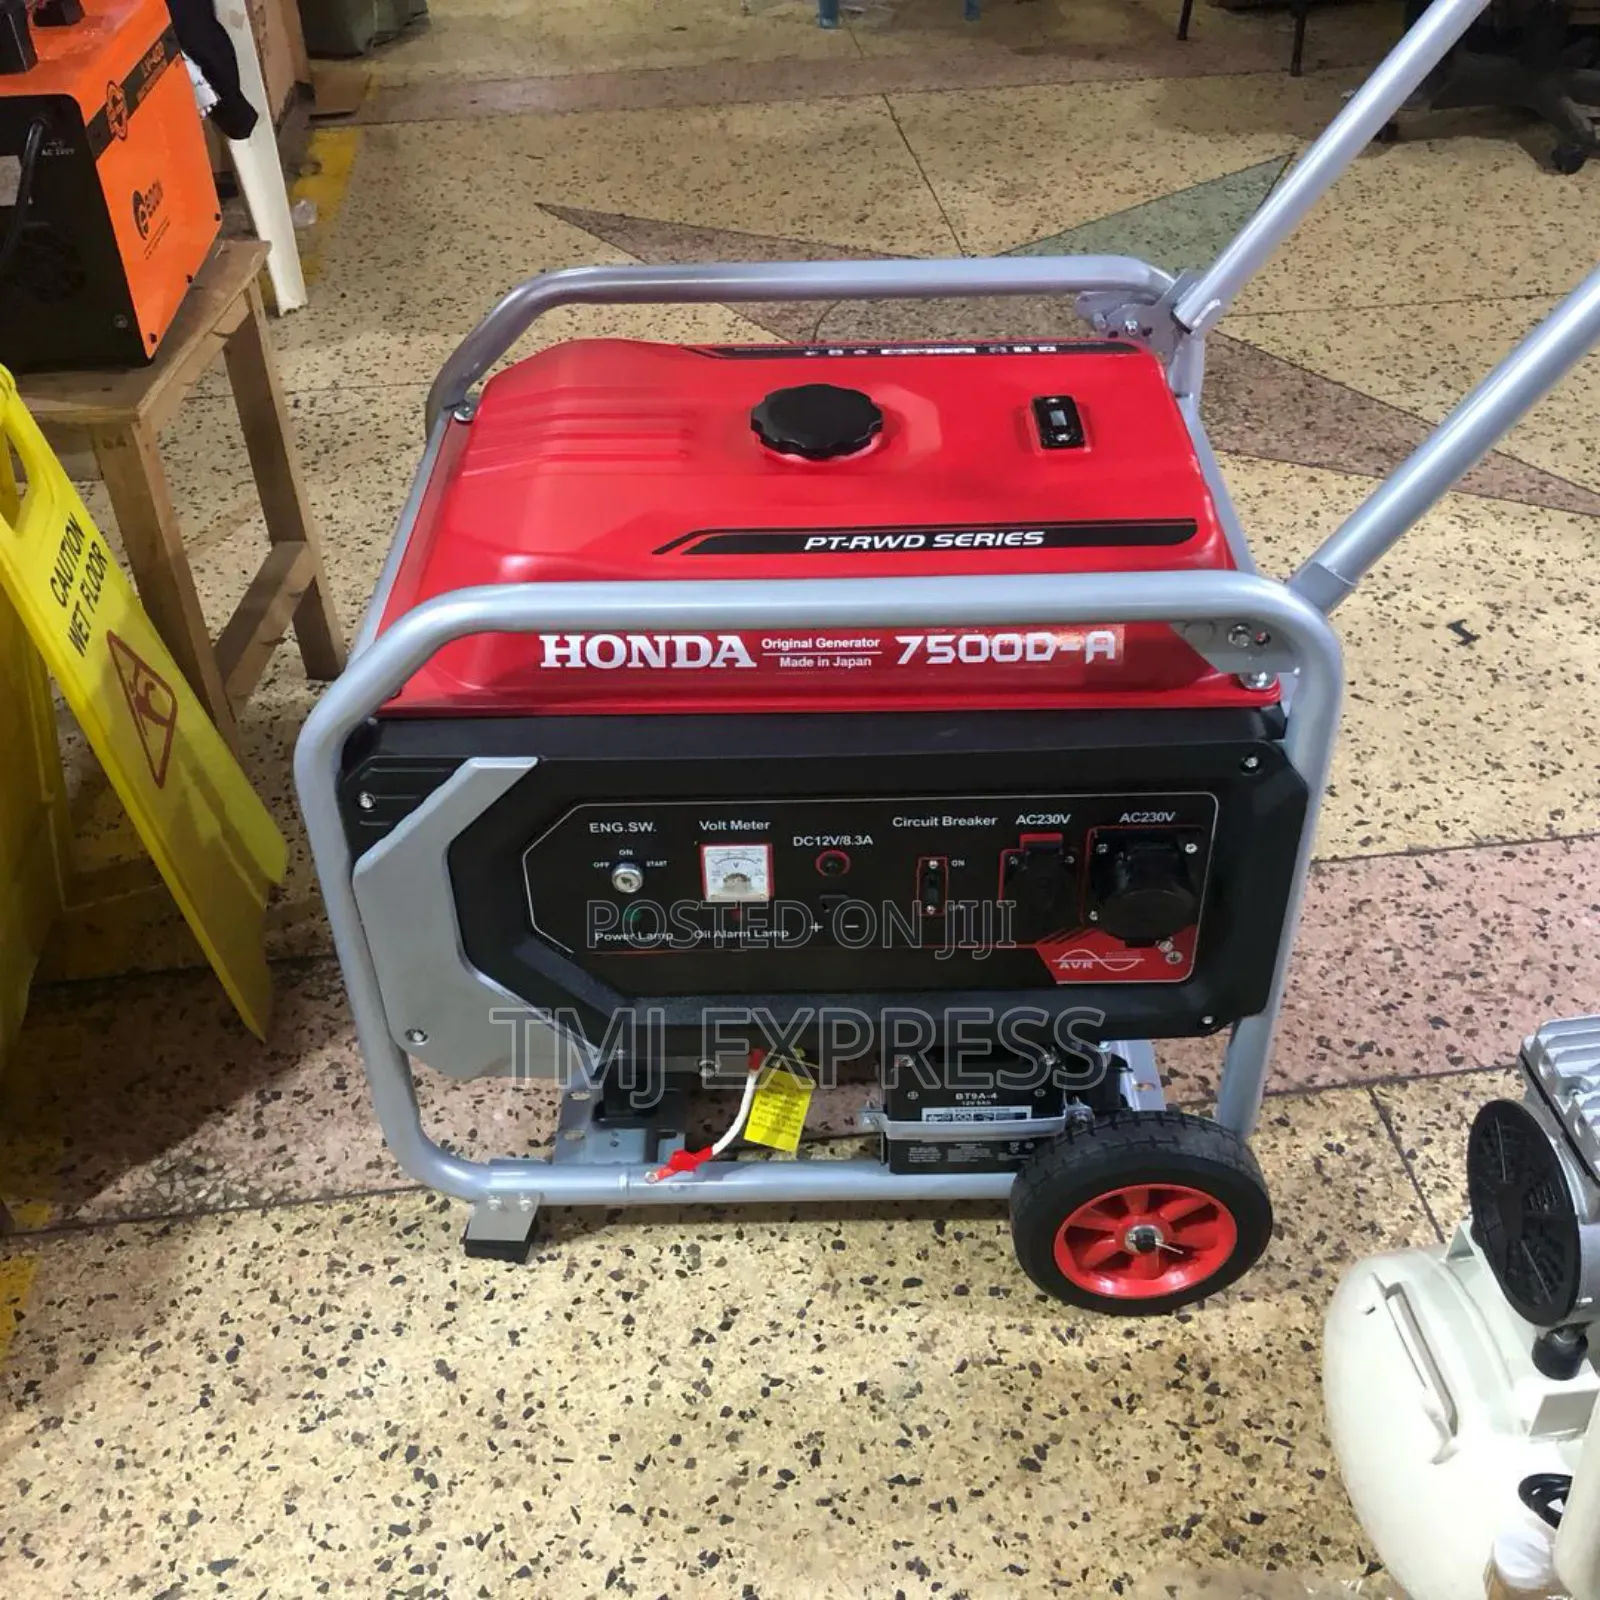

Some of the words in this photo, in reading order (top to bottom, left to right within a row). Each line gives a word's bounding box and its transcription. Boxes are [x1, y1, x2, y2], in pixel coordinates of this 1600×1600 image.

[803, 533, 924, 552] PT-RWD
[931, 531, 1045, 549] SERIES
[50, 511, 86, 608] CAUTION
[68, 600, 92, 659] WET
[80, 540, 108, 614] FLOOR
[761, 637, 813, 651] Original
[815, 637, 881, 648] Generator
[895, 631, 1118, 665] 7500D-A
[539, 634, 757, 669] HONDA
[779, 656, 815, 668] Made
[817, 656, 830, 667] in
[832, 656, 873, 669] Japan
[892, 815, 939, 828] Circuit
[941, 815, 998, 827] Breaker
[1015, 813, 1072, 826] AC230V
[1118, 811, 1177, 824] AC230V
[588, 821, 658, 834] ENG.SW.
[698, 820, 728, 831] Volt
[729, 820, 772, 831] Meter
[793, 834, 875, 847] DC12V/8.3A
[950, 859, 966, 867] ON
[594, 932, 634, 942] Power
[637, 931, 675, 943] Lamp
[692, 929, 711, 939] Oil
[713, 929, 751, 939] Alarm
[753, 928, 789, 941] Lamp
[1059, 960, 1093, 970] AVR
